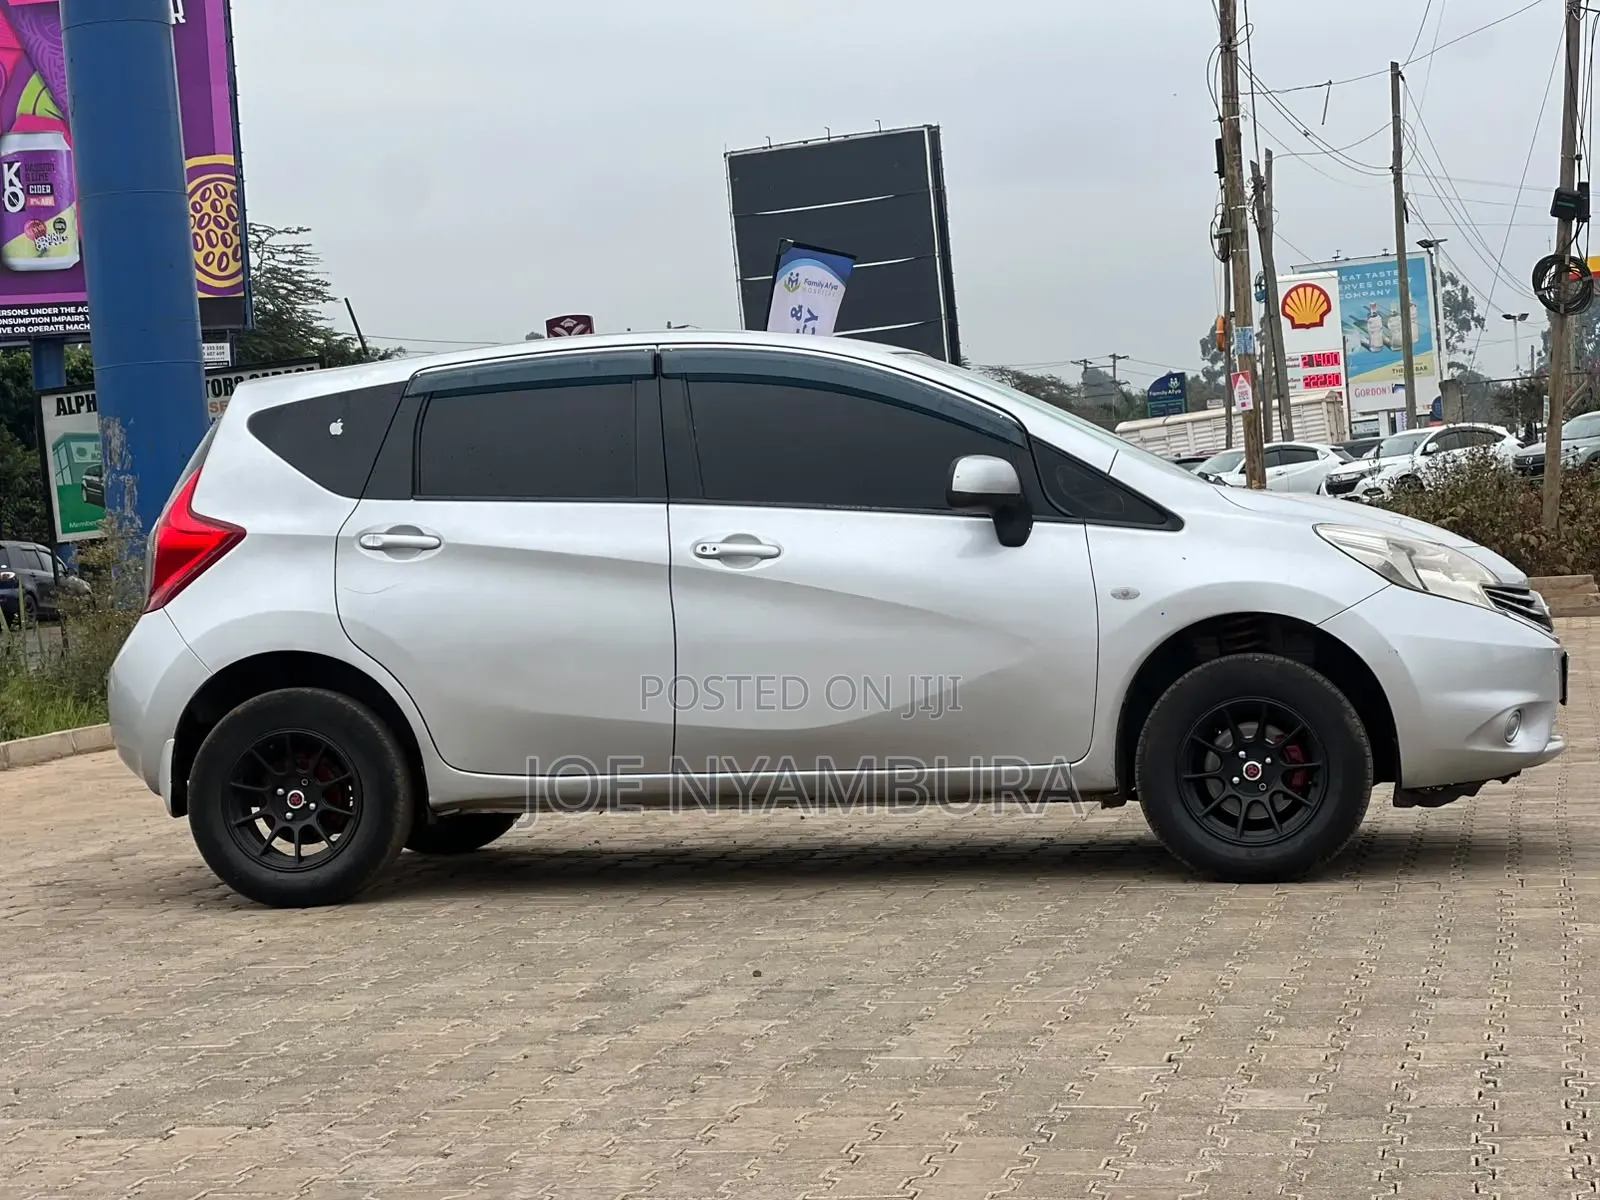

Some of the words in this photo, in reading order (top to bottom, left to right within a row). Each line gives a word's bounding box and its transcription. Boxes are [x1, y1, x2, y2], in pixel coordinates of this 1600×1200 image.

[29, 184, 51, 194] CIDER
[1365, 270, 1399, 279] TASTE
[30, 307, 58, 315] UNDER
[52, 315, 85, 323] IMPAIRS
[27, 324, 64, 332] OPERATE
[55, 394, 97, 416] ALPH
